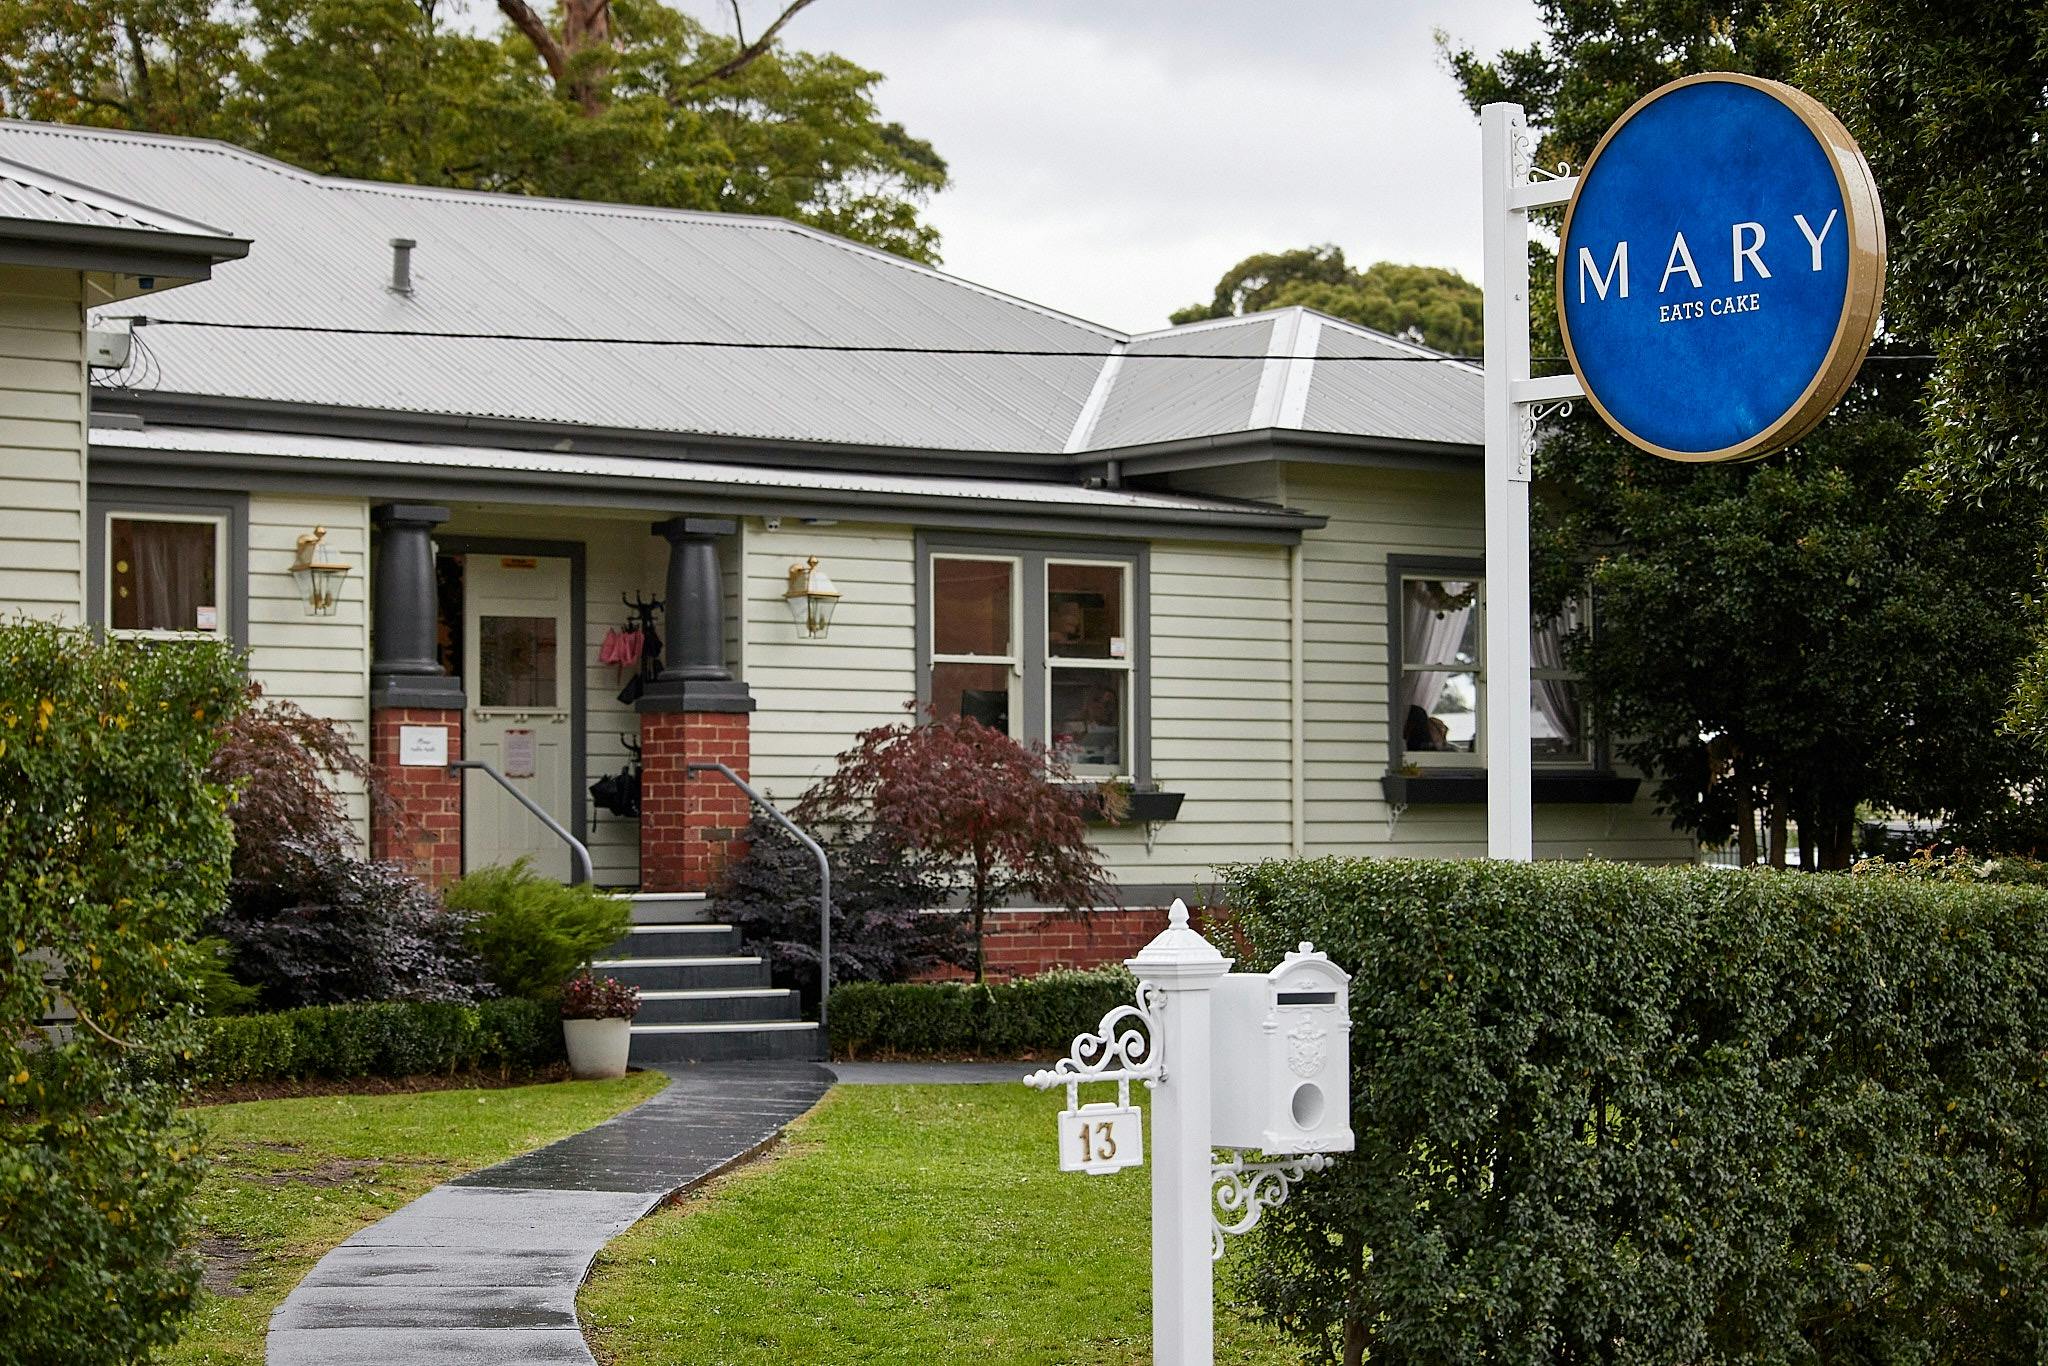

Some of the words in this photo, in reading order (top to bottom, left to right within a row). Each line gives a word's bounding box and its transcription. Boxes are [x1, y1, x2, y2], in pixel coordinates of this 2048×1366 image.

[1579, 209, 1837, 303] MARY
[1659, 301, 1704, 323] EATS
[1710, 293, 1760, 316] CAKE
[1079, 1122, 1116, 1161] 13
